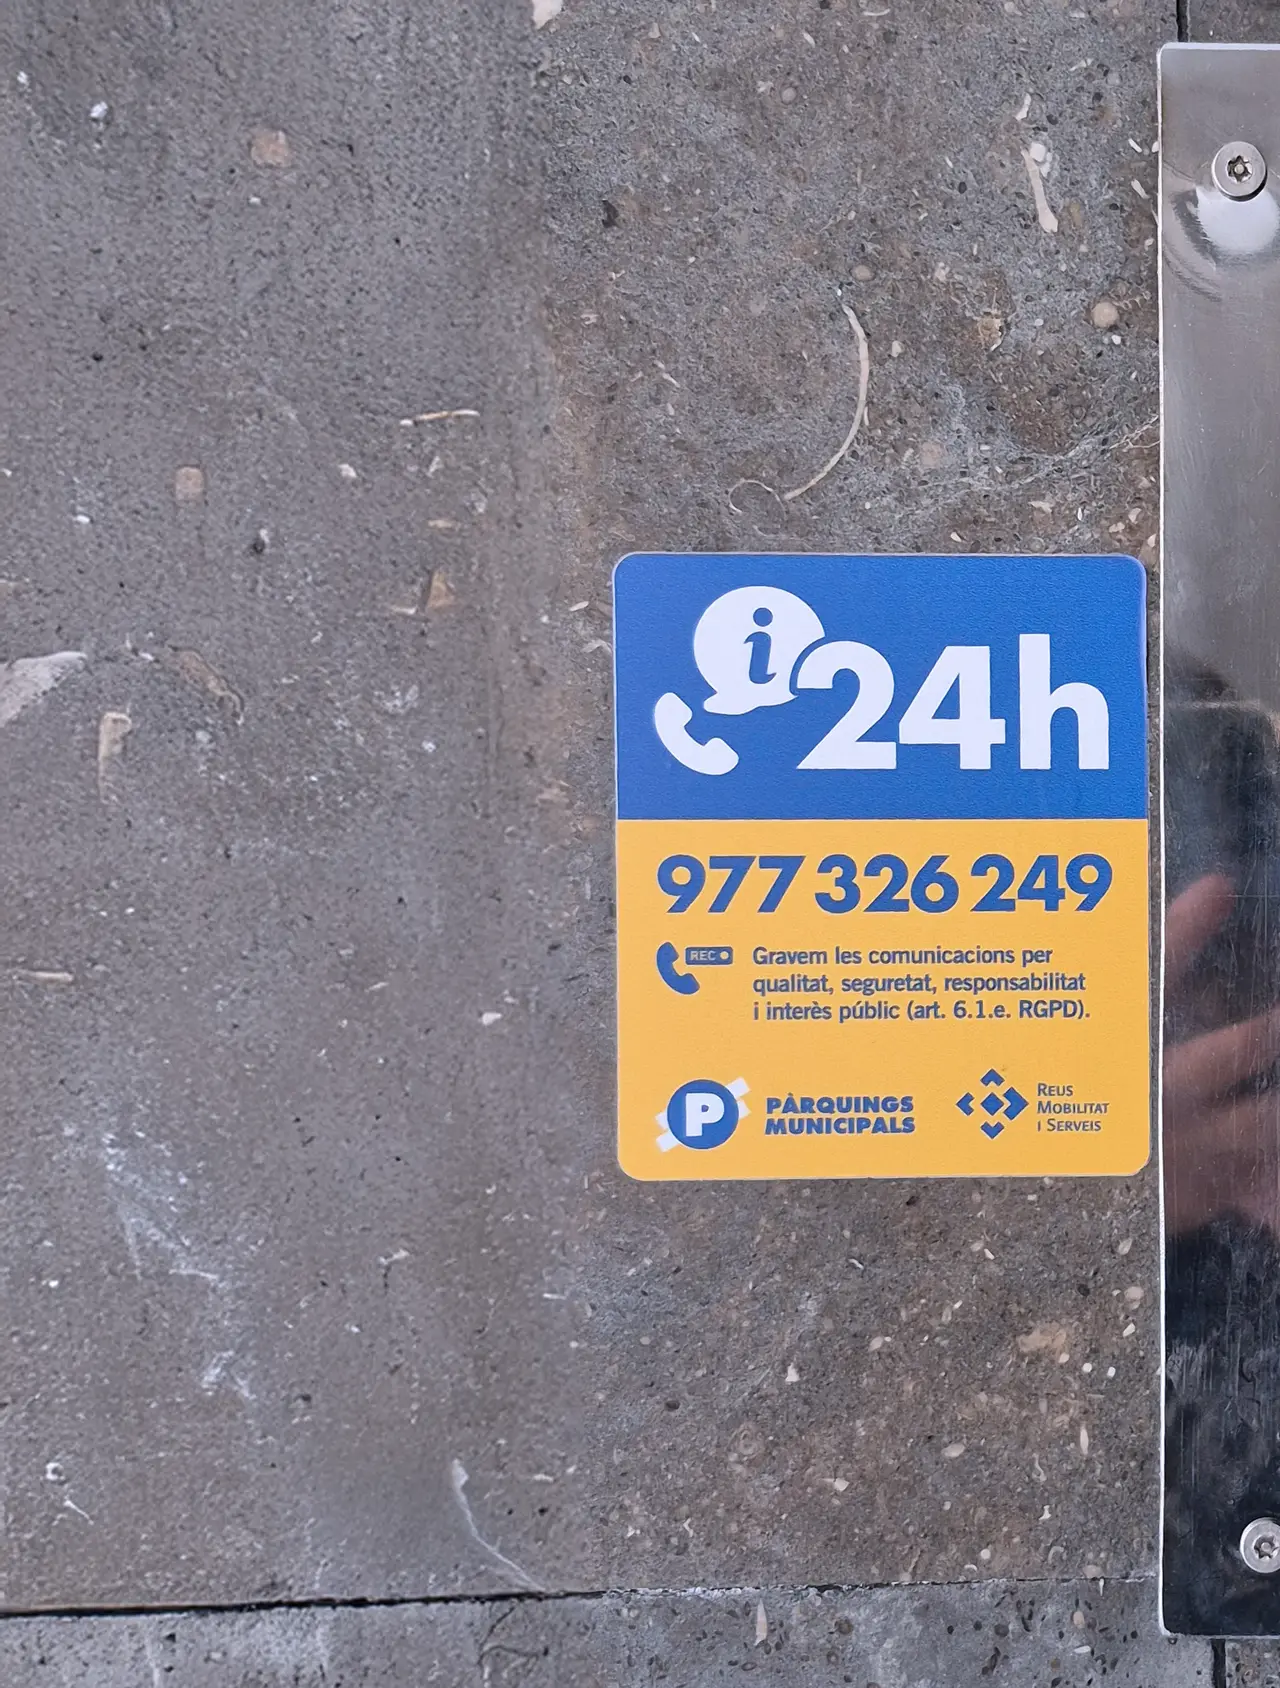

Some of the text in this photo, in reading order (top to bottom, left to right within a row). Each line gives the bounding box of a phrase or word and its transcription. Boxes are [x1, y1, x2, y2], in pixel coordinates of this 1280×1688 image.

[796, 632, 1109, 769] 24h
[656, 853, 1113, 915] 977 326 249
[690, 950, 717, 961] REC
[752, 944, 1054, 968] Gravem les comunicacions per
[752, 971, 1087, 997] qualitat, seguretat, responsabilitat
[753, 999, 1090, 1024] i interès públic (art. 6.1.e. RGPD).
[685, 1092, 725, 1137] P
[766, 1092, 914, 1116] PÀRQUINGS
[764, 1116, 916, 1136] MUNICIPALS
